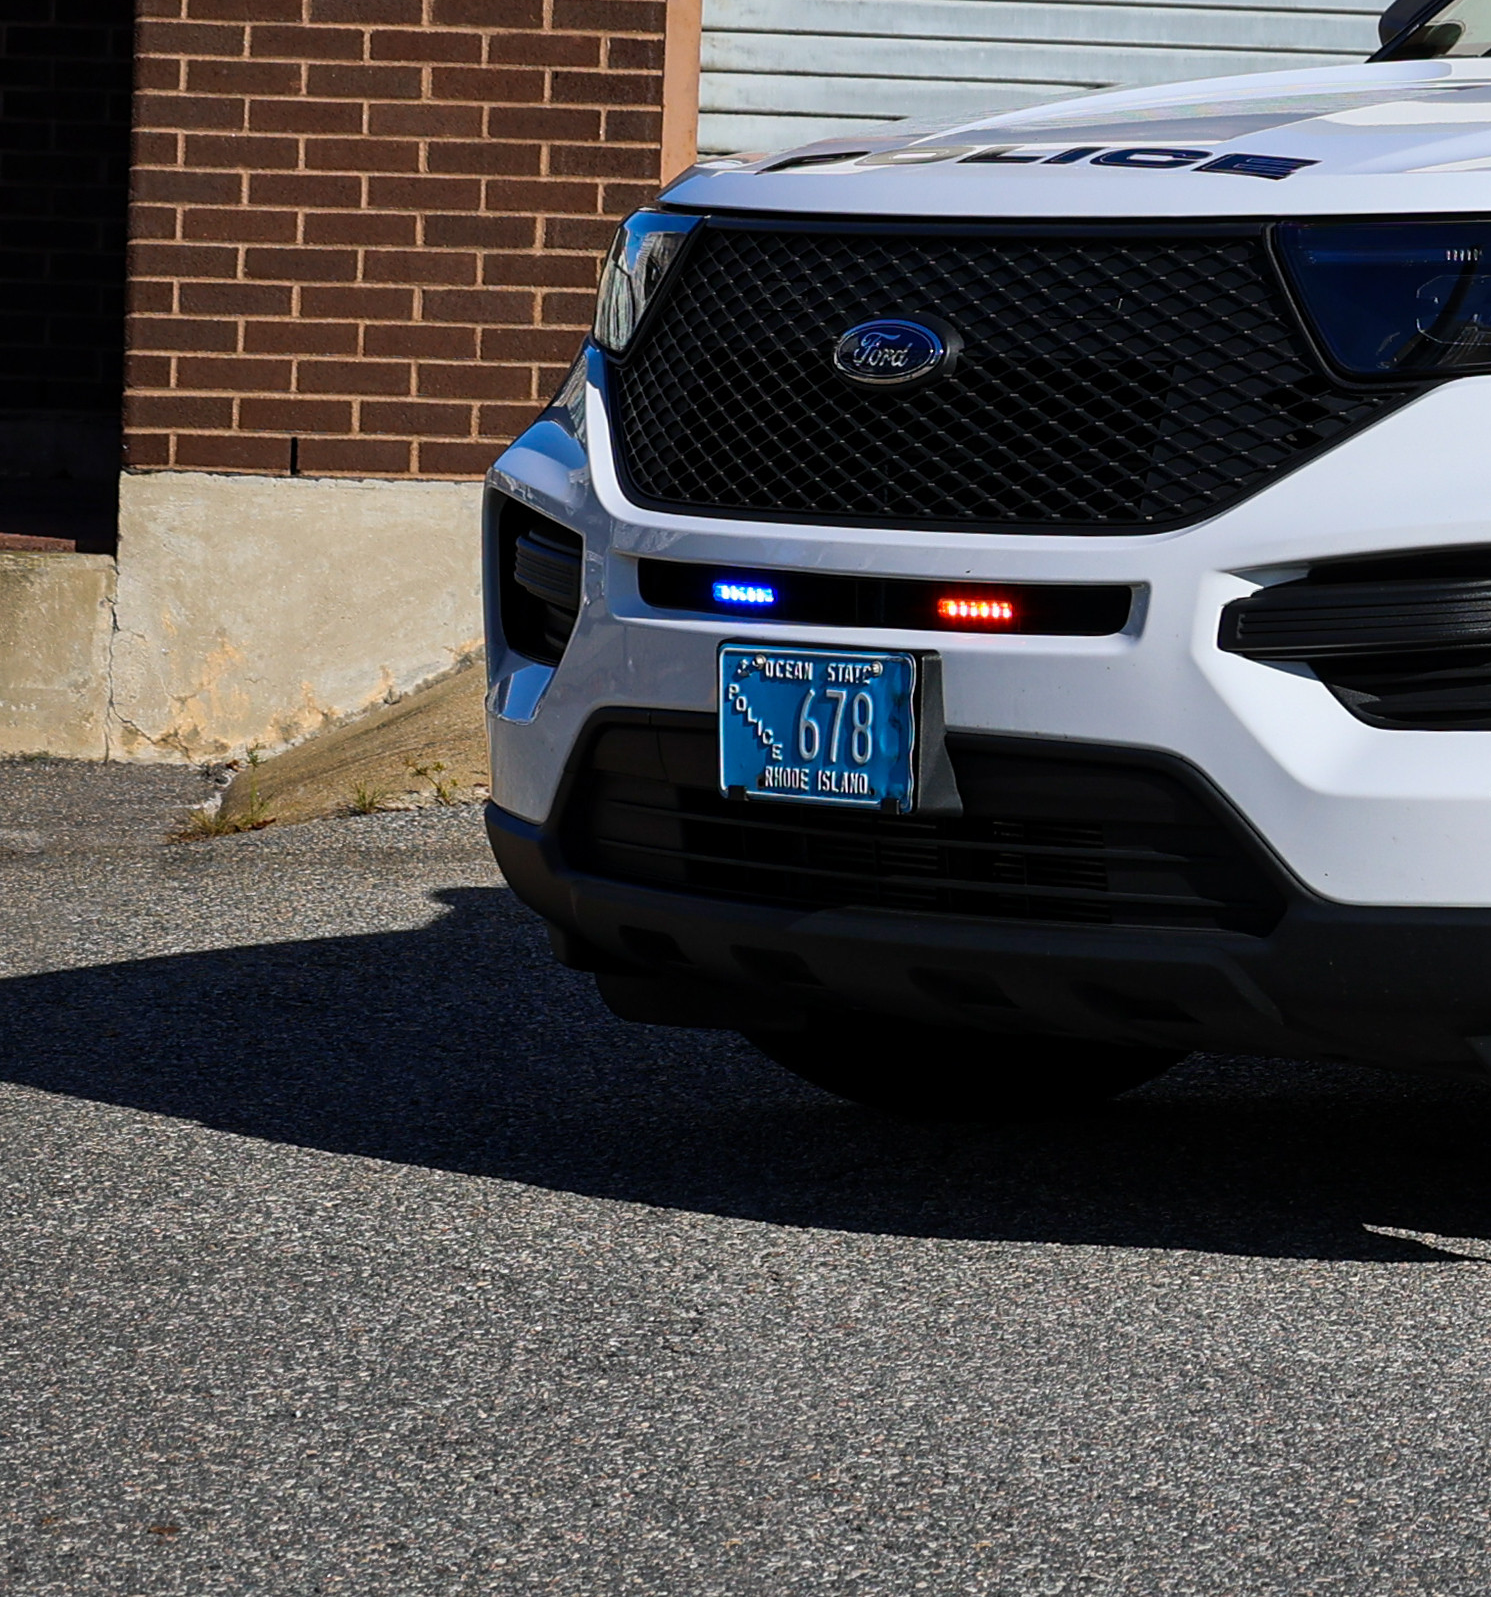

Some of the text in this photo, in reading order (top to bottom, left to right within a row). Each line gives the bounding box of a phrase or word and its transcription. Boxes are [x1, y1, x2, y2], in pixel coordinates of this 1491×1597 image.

[754, 145, 1324, 181] POLICE
[853, 331, 914, 368] Ford
[765, 658, 814, 681] OCEAN
[728, 683, 783, 762] POLICE
[798, 687, 874, 765] 678
[764, 765, 870, 795] RHODE ISLAND
